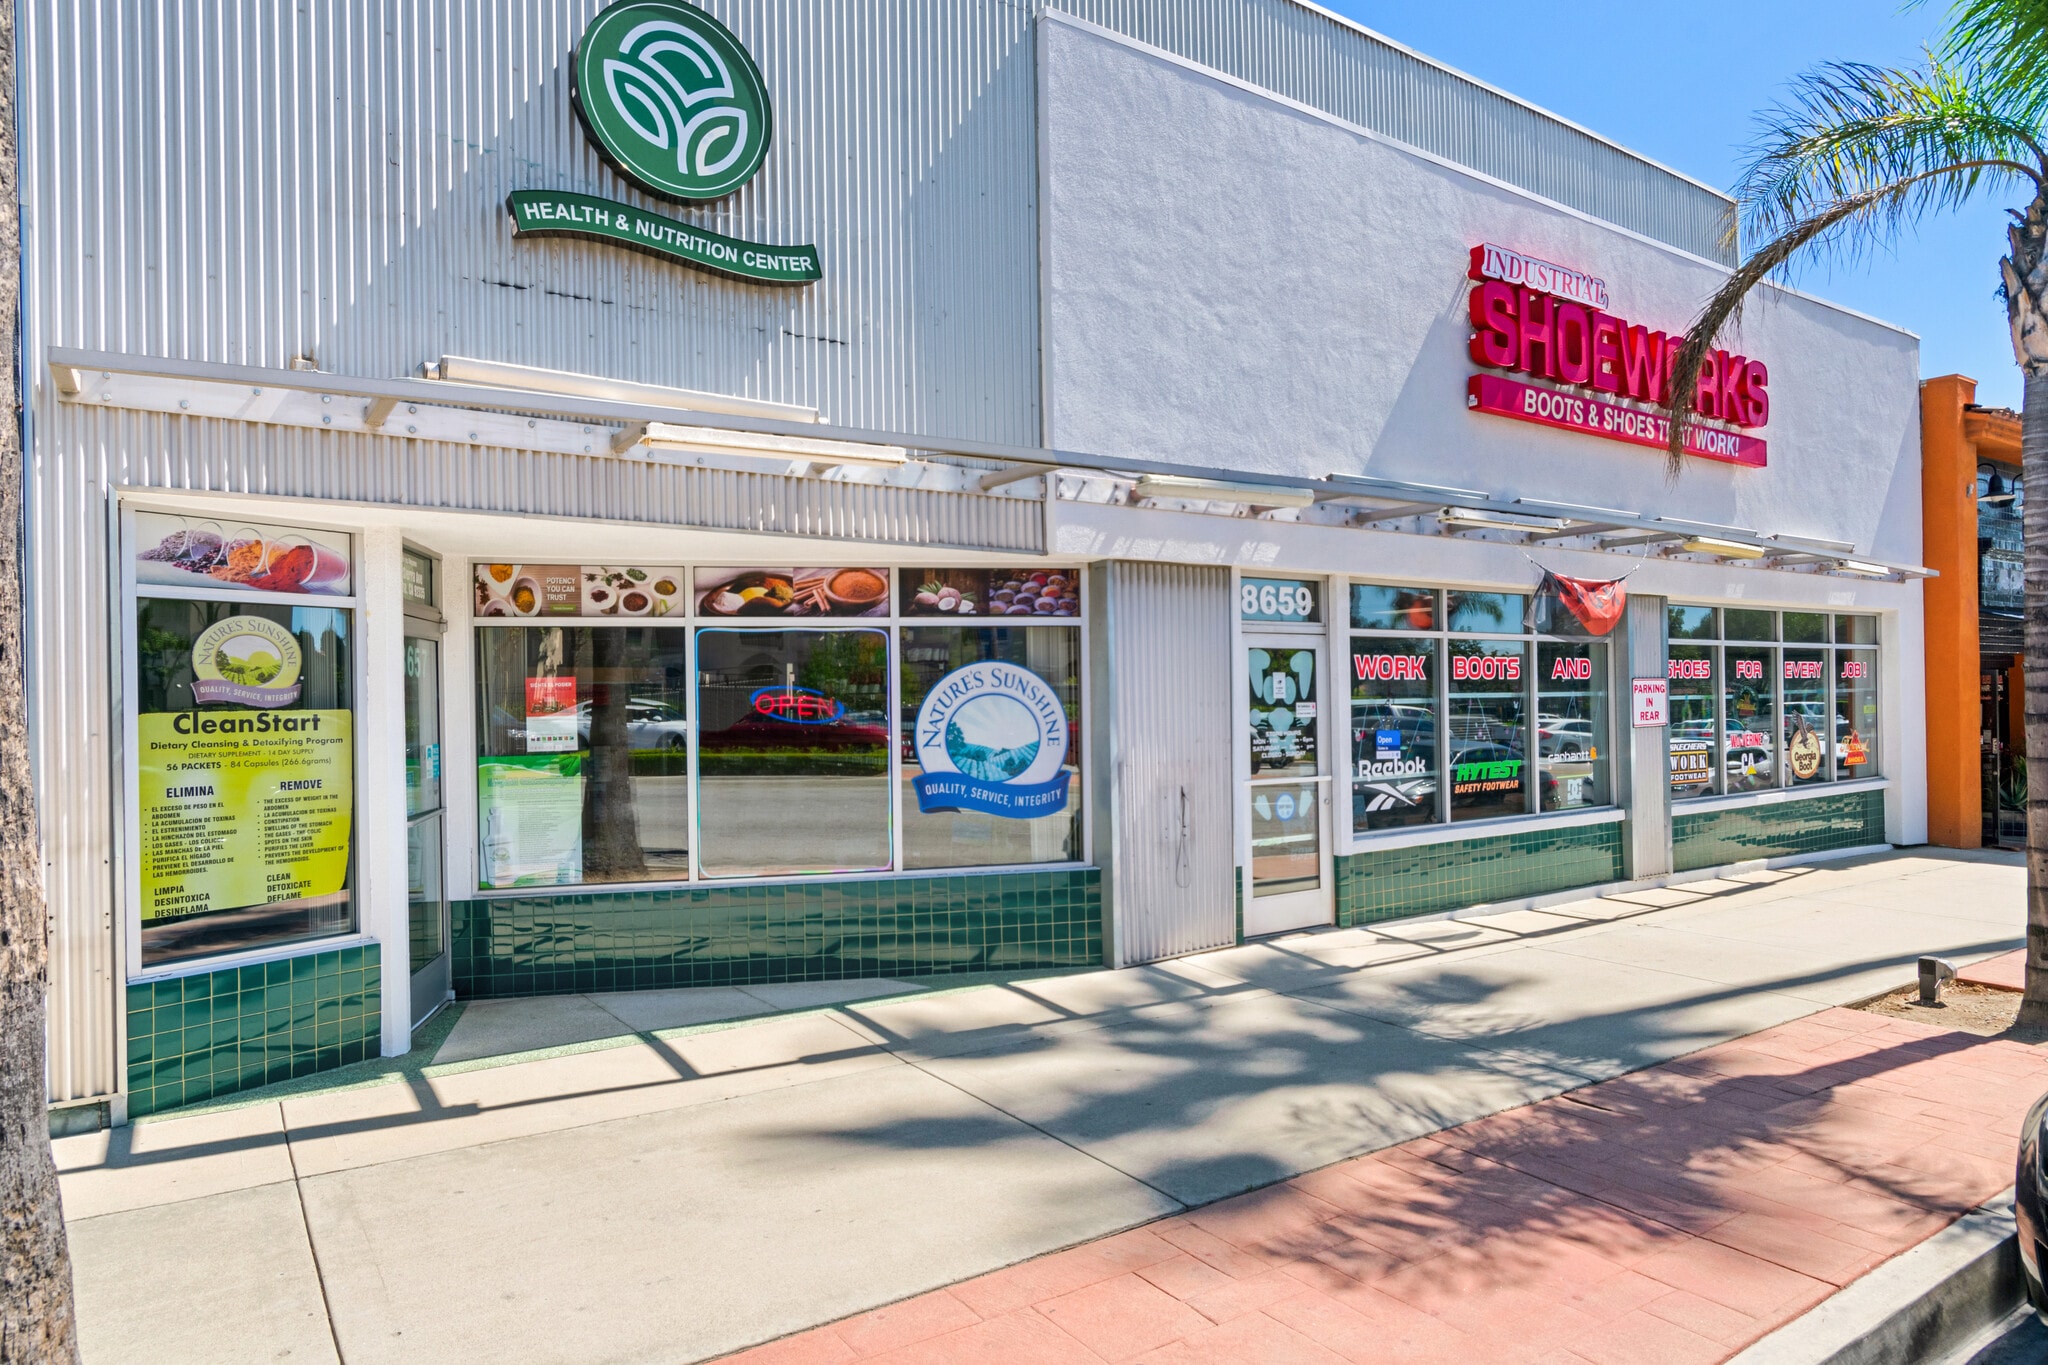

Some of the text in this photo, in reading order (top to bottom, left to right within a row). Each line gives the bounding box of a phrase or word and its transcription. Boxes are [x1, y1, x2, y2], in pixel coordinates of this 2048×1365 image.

[523, 202, 813, 272] HEALTH & NUTRITION CENTER
[1484, 245, 1609, 310] INDUSTRIAL
[1470, 280, 1768, 428] SHOEWRKS
[1524, 388, 1739, 457] BOOTS & SHOES TT WORK!
[1241, 584, 1312, 616] 8659
[248, 619, 296, 667] SUNSHINE
[1354, 654, 1592, 680] WORK BOOTS AND
[1668, 660, 1710, 679] SHOES
[1736, 660, 1762, 679] FOR
[1784, 661, 1823, 679] EVERY
[200, 685, 298, 702] QUALITY, SERVICE, INTEGRITY
[1633, 684, 1666, 694] PARKING
[755, 694, 834, 716] OPEN
[990, 668, 1060, 747] SUNSHINE
[1646, 698, 1653, 707] IN
[1640, 711, 1660, 721] REAR
[173, 712, 321, 735] CleanStart
[150, 737, 343, 750] Dietary Cleansing & Detoxifying Program
[1378, 736, 1392, 744] Open
[1670, 743, 1706, 751] SKECHERS
[188, 751, 216, 760] DIETARY
[218, 750, 261, 758] SUPPLEMENT
[1548, 751, 1590, 762] carhartt
[1795, 751, 1816, 761] Georgia
[166, 763, 178, 771] 56
[181, 762, 221, 771] PACKETS
[244, 759, 279, 769] Capsules
[1359, 756, 1425, 782] Reebok
[1670, 754, 1706, 771] WORK
[1799, 761, 1812, 771] Boot
[1456, 760, 1521, 781] HYTEST
[166, 785, 214, 799] ELIMINA
[280, 780, 322, 790] REMOVE
[1455, 780, 1518, 794] SAFETY FOOTWEAR
[925, 783, 1061, 807] QUALITY, SERVICE, INTEGRITY
[191, 858, 226, 866] DESARROLLO
[267, 872, 291, 883] CLEAN
[154, 885, 184, 896] LIMPIA
[267, 880, 311, 893] DETOXICATE
[154, 893, 210, 907] DESINTOXICA
[267, 891, 302, 903] DEFLAME
[155, 904, 209, 918] DESINFLAMA
